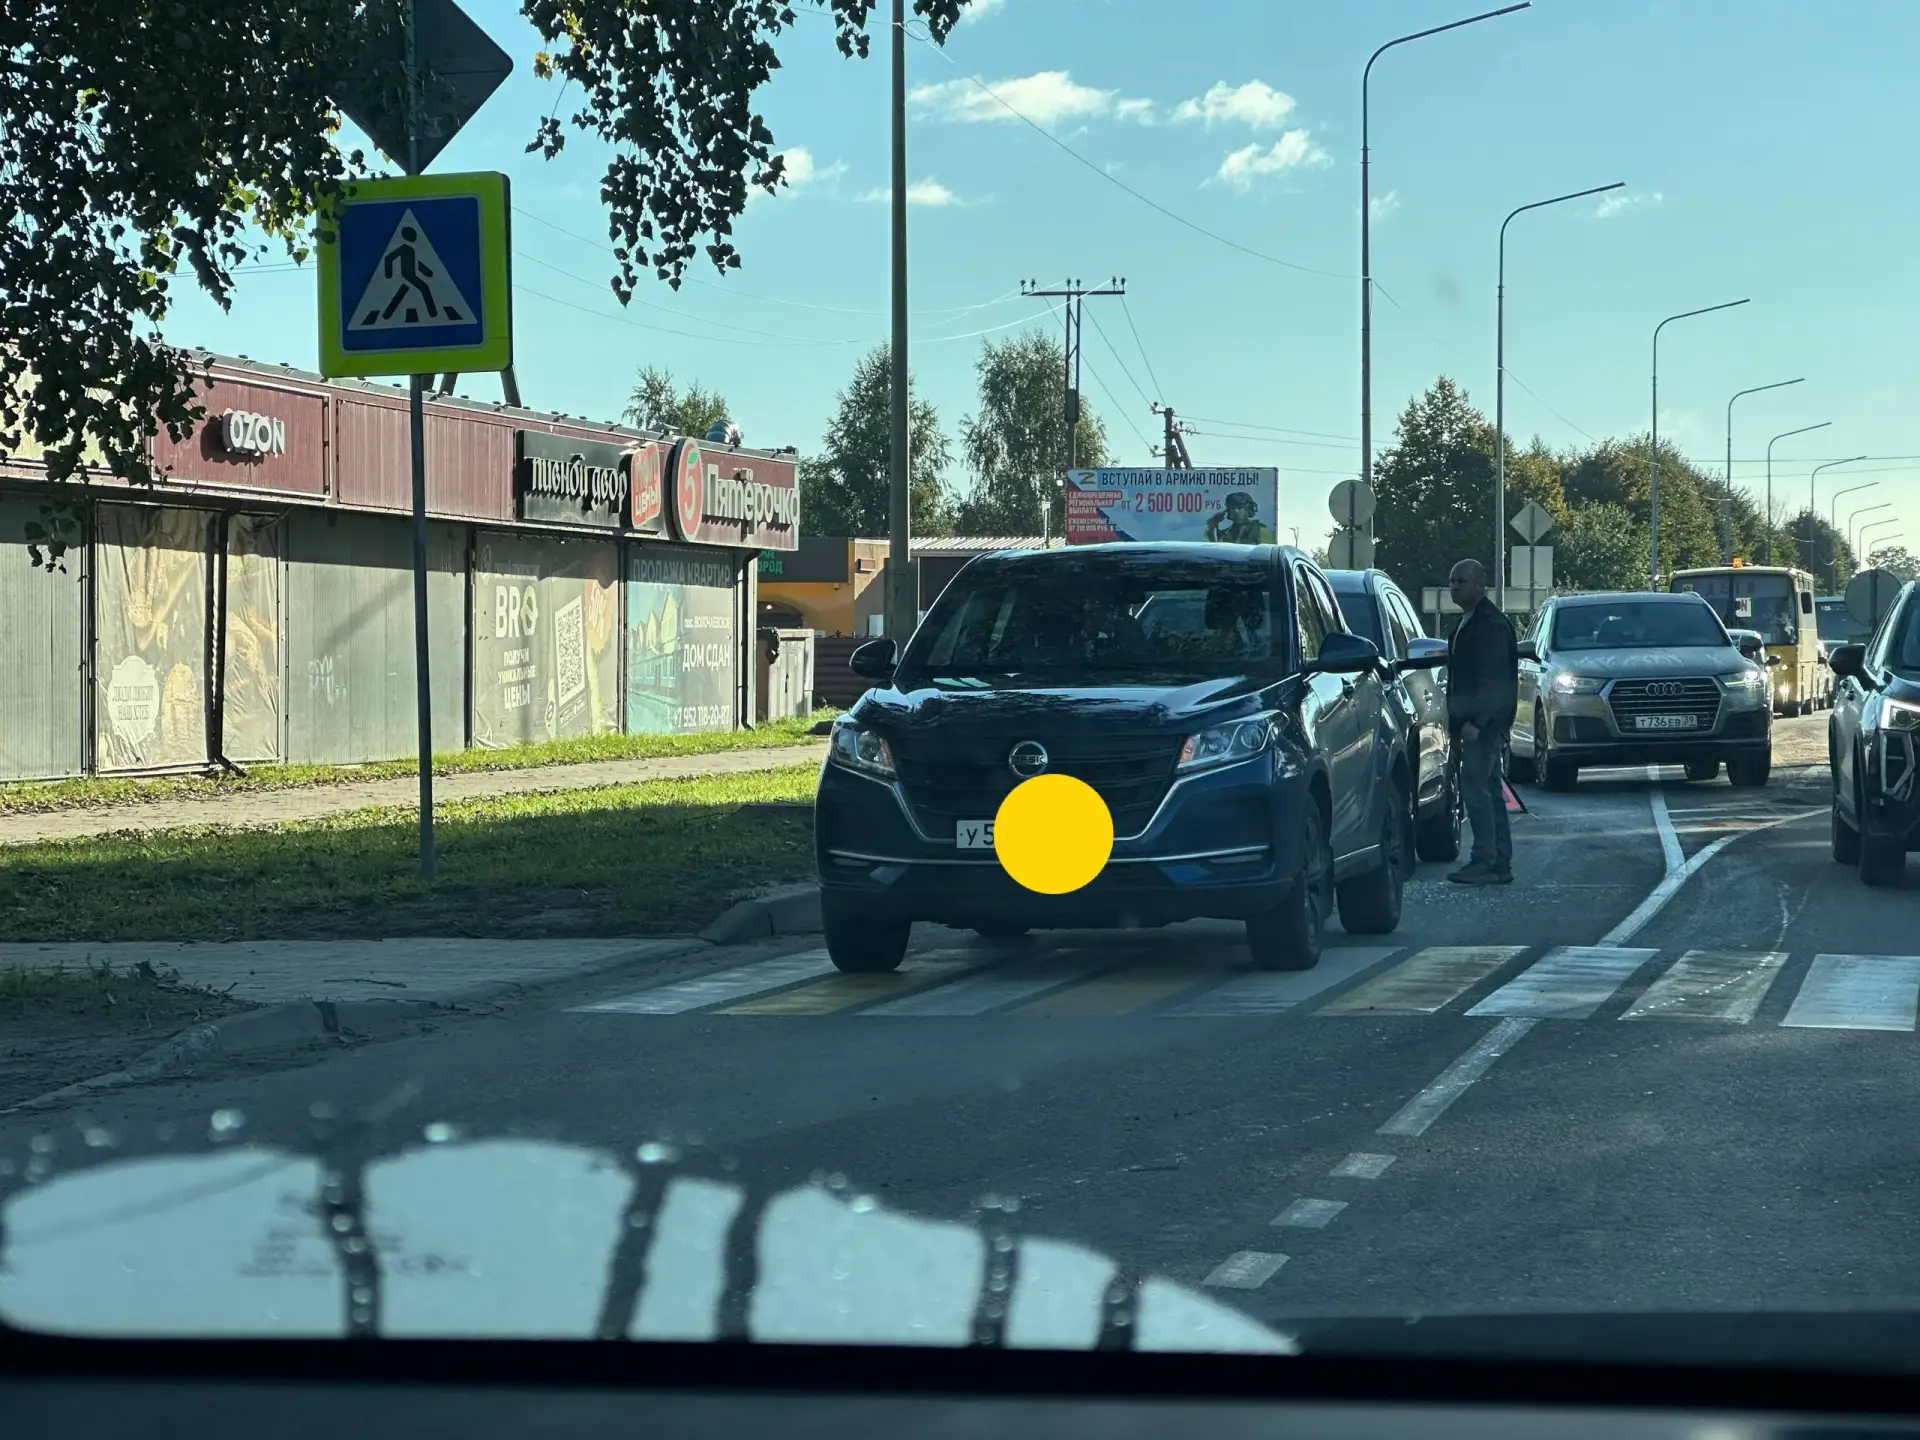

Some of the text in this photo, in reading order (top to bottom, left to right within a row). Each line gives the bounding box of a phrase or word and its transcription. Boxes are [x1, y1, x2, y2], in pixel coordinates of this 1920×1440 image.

[228, 410, 285, 455] OZON
[591, 465, 628, 513] двор
[1101, 470, 1259, 487] ВСТУПАЙ В АРМИЮ ПОБЕДЫ!
[707, 463, 800, 536] Пятёрочка
[1121, 500, 1131, 510] ОТ
[1135, 492, 1144, 513] 2
[1148, 492, 1173, 513] 500
[633, 558, 732, 589] ПРОДАЖА КВАРТИР
[503, 648, 530, 666] ПОЛУЧИ
[682, 643, 731, 672] ДОМ СДАН
[504, 684, 530, 712] ЦЕНЫ
